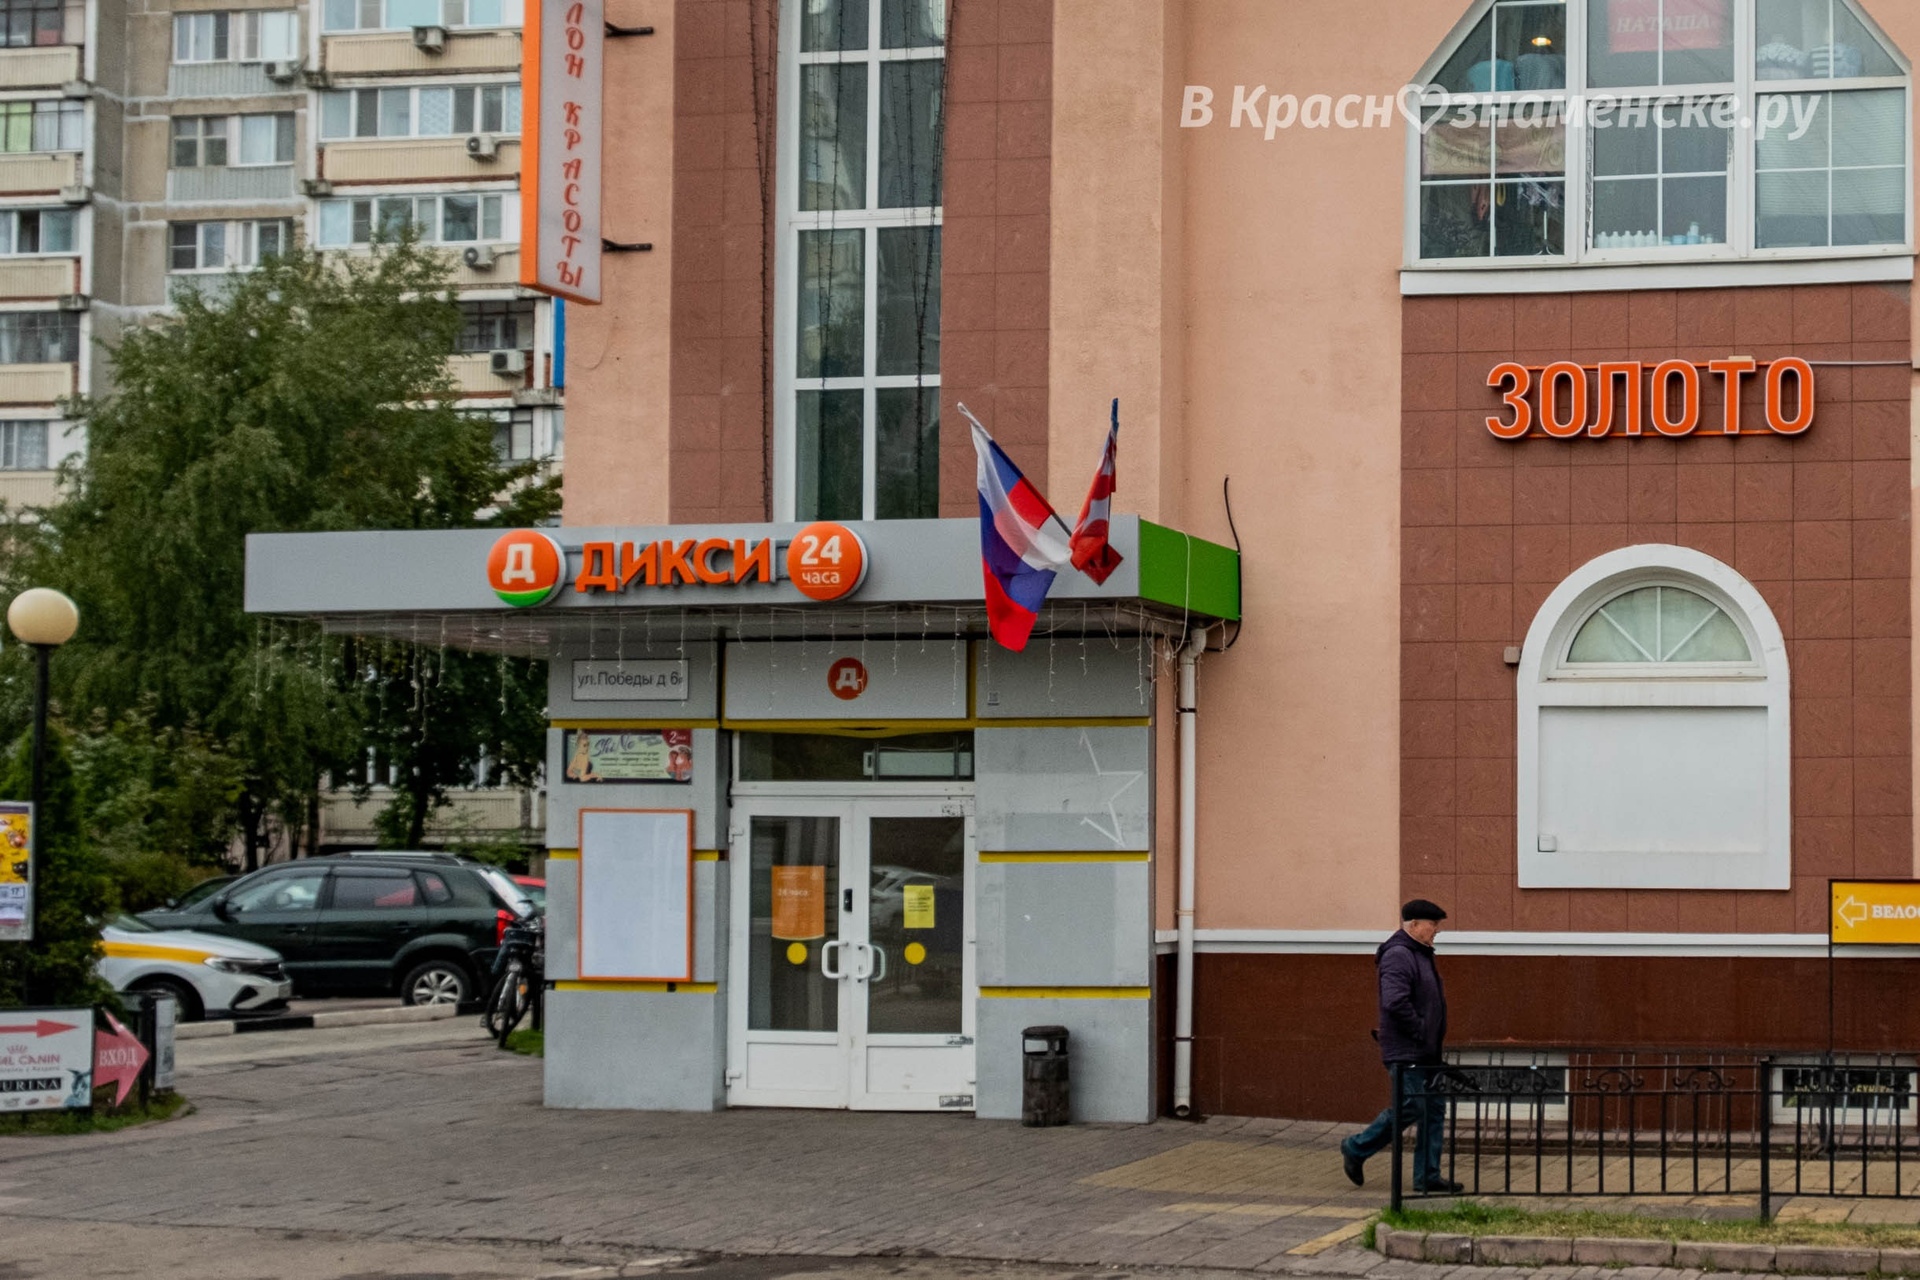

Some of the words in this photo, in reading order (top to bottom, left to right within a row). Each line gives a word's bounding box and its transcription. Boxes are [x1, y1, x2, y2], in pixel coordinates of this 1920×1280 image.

[556, 101, 583, 288] КРАСОТЫ
[1485, 356, 1815, 440] ЗОЛОТО
[800, 535, 843, 565] 24
[574, 537, 772, 594] ДИКСИ
[802, 571, 841, 585] часа
[656, 675, 667, 688] д
[1872, 905, 1920, 919] ВЕЛО
[18, 1054, 61, 1066] CANIN
[100, 1047, 138, 1070] ВХОД
[0, 1079, 59, 1091] URINA
